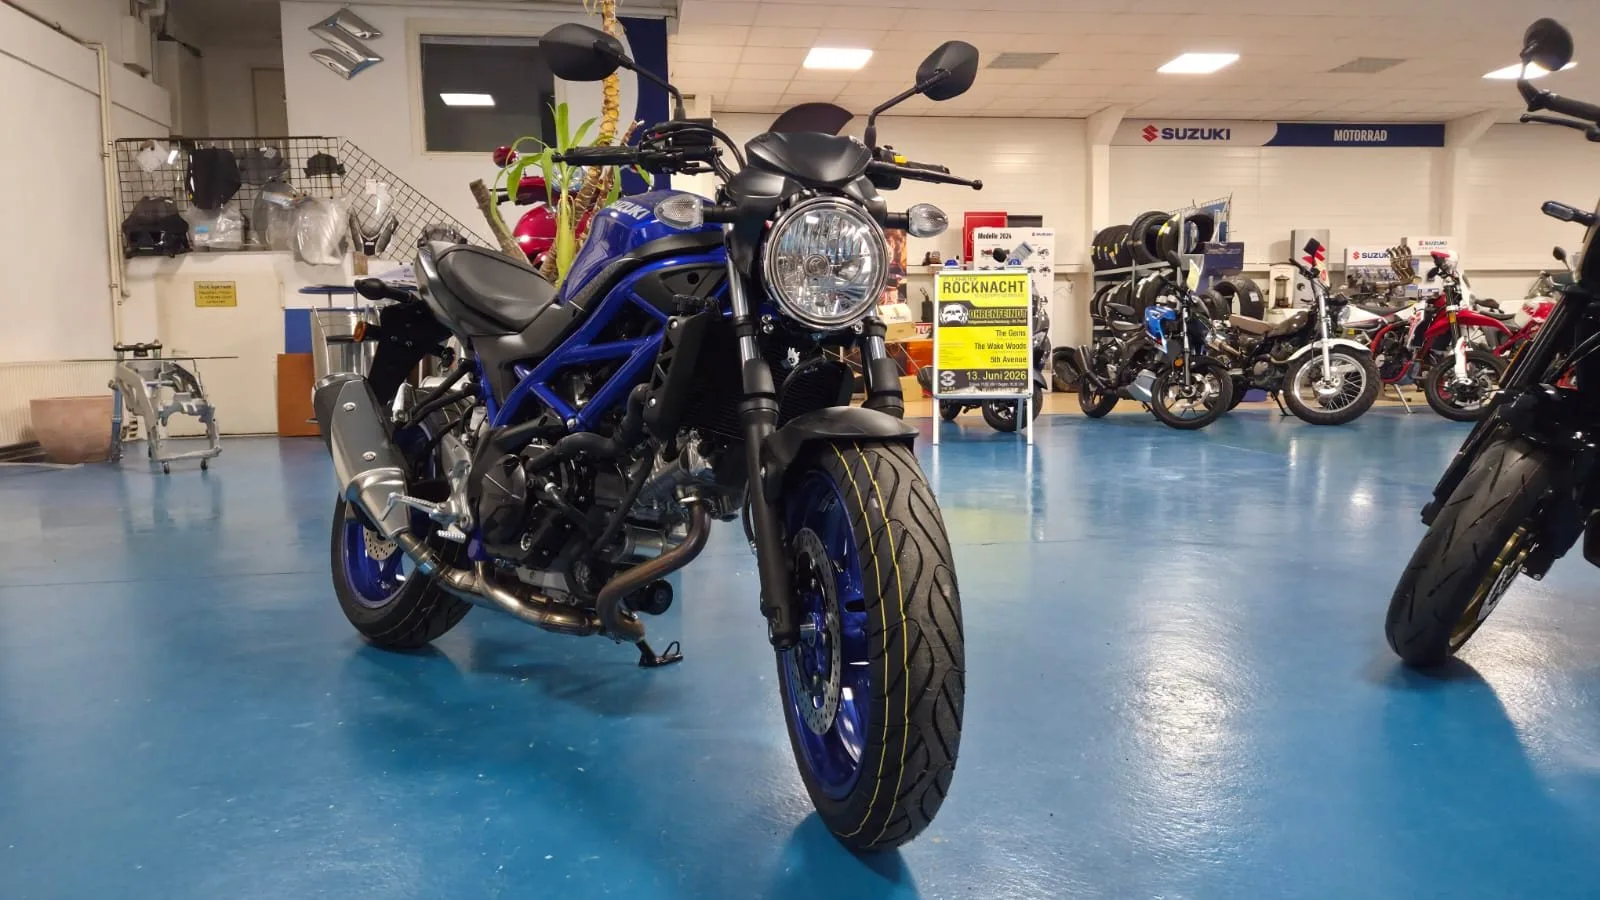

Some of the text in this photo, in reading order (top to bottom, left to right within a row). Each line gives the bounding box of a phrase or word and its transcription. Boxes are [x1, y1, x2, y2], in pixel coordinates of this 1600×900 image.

[1161, 127, 1231, 141] SUZUKI
[1333, 128, 1388, 142] MOTORRAD
[977, 232, 1012, 240] Modelle 2024
[1361, 251, 1390, 259] SUZUK
[943, 280, 1025, 294] ROCKNACHT
[995, 329, 1007, 337] The
[974, 342, 1026, 350] The Wake Woods
[990, 355, 1027, 363] 5th Avenue
[966, 370, 1027, 381] 13. Juni 2026
